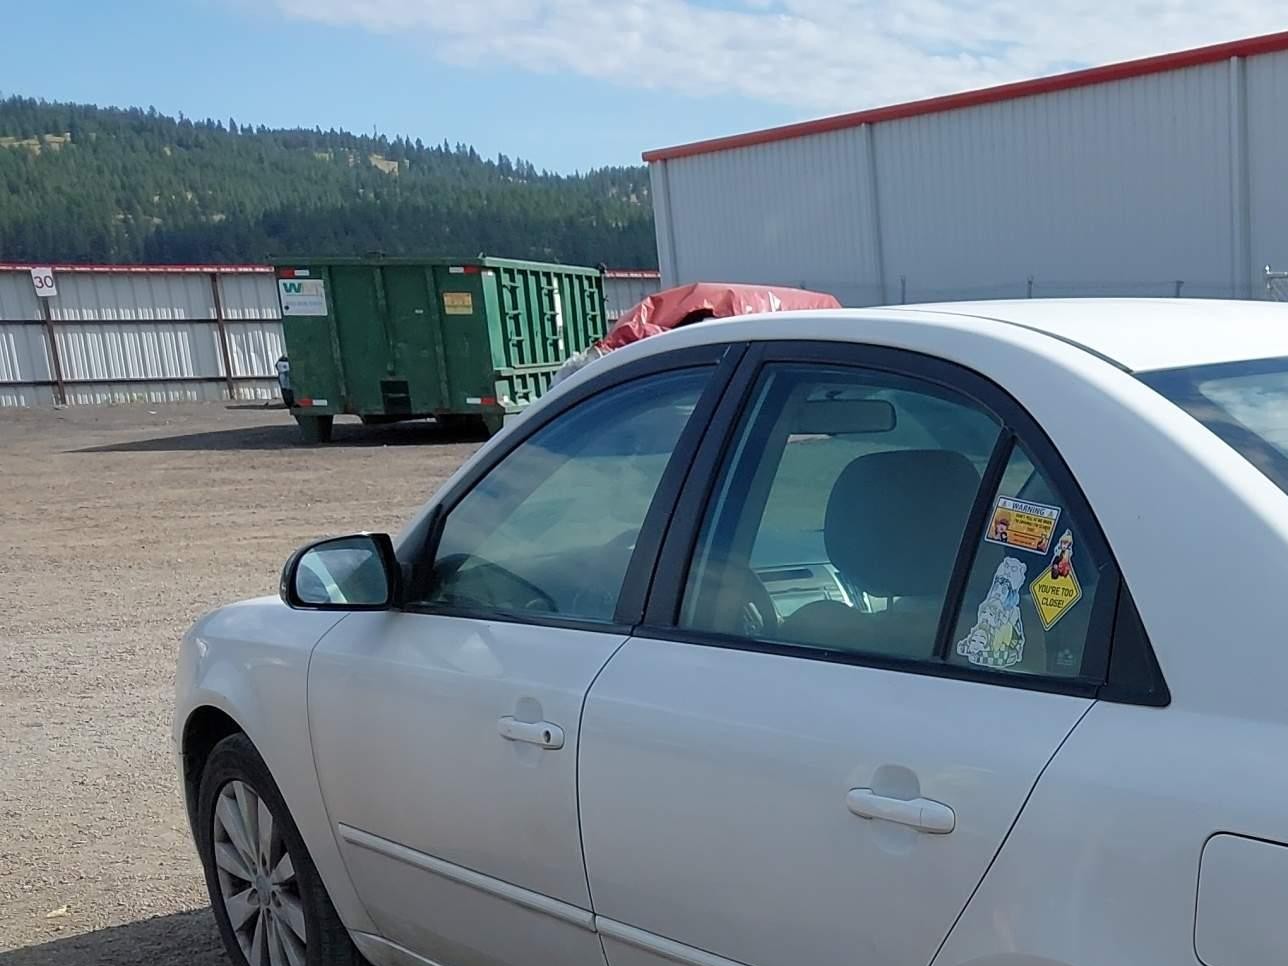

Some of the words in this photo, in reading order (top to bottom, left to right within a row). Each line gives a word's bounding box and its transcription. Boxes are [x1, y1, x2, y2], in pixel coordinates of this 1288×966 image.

[33, 275, 54, 289] 30
[1013, 502, 1045, 516] WARNING
[1038, 583, 1061, 596] YOU'RE
[1061, 587, 1074, 597] TOO
[1041, 596, 1065, 608] CLOSE!
